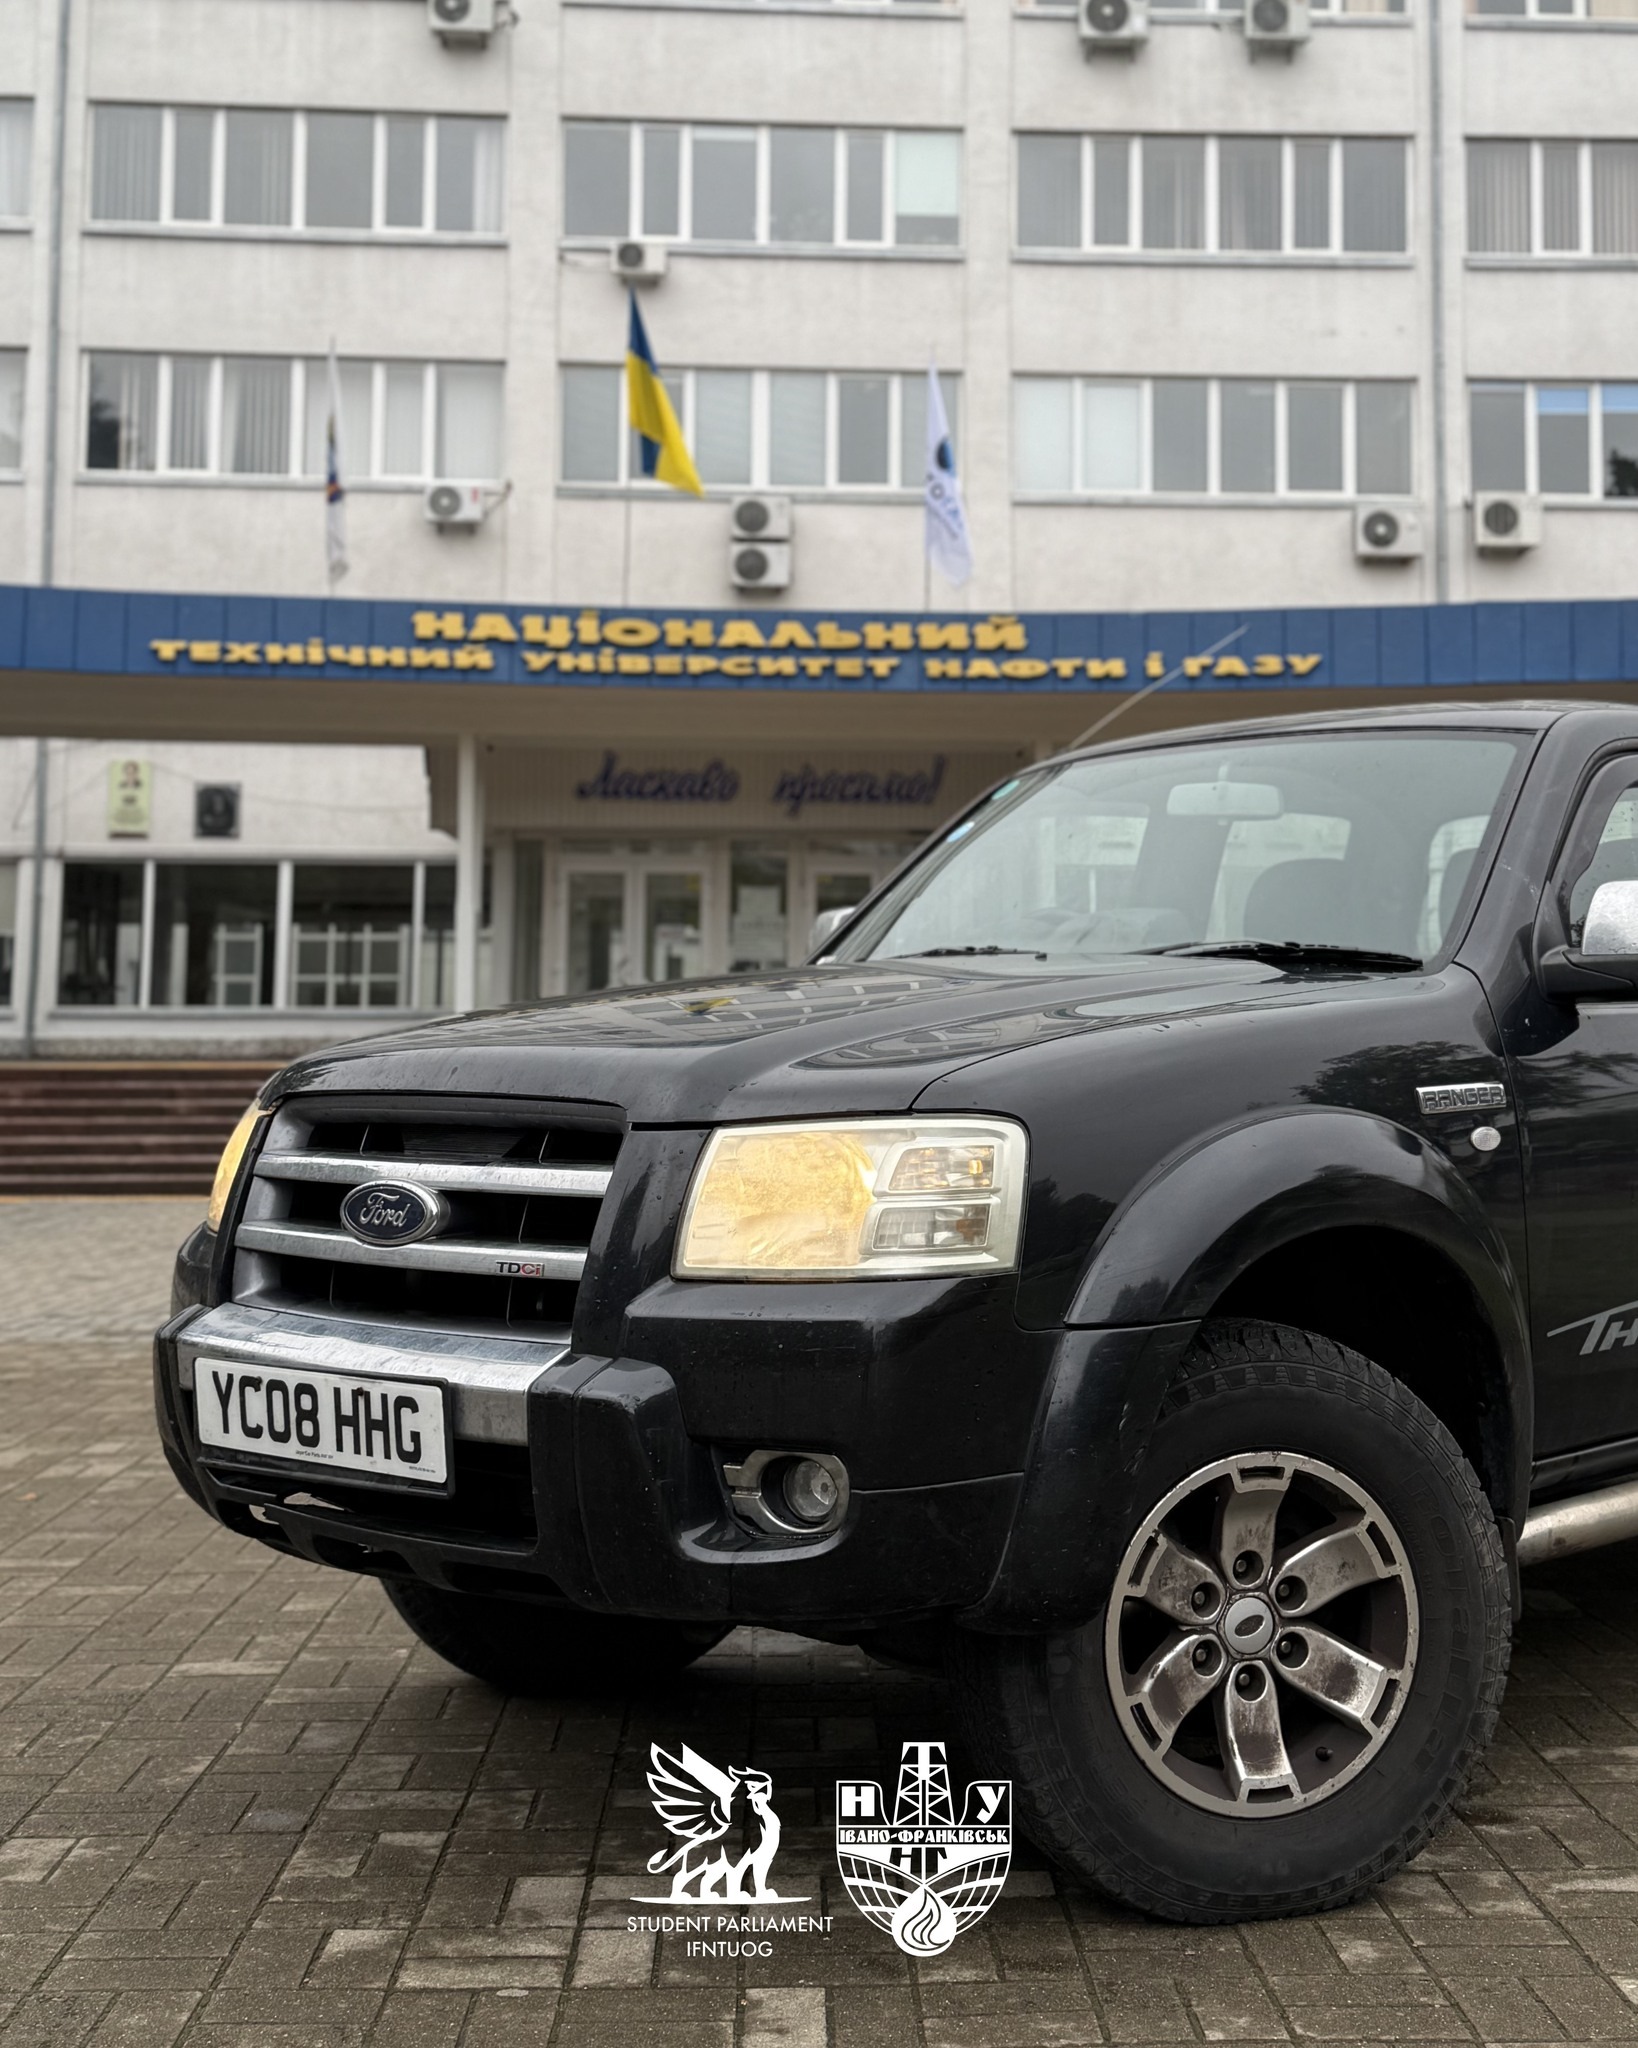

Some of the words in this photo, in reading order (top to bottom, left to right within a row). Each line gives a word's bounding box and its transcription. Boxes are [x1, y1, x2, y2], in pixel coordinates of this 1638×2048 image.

[923, 656, 1127, 680] НАФТИ
[1182, 653, 1323, 678] ГАЗУ
[1421, 1086, 1505, 1111] RANGER
[360, 1191, 411, 1228] Ford
[496, 1261, 543, 1276] TDCi
[211, 1370, 320, 1449] YC08
[333, 1386, 422, 1464] HHG
